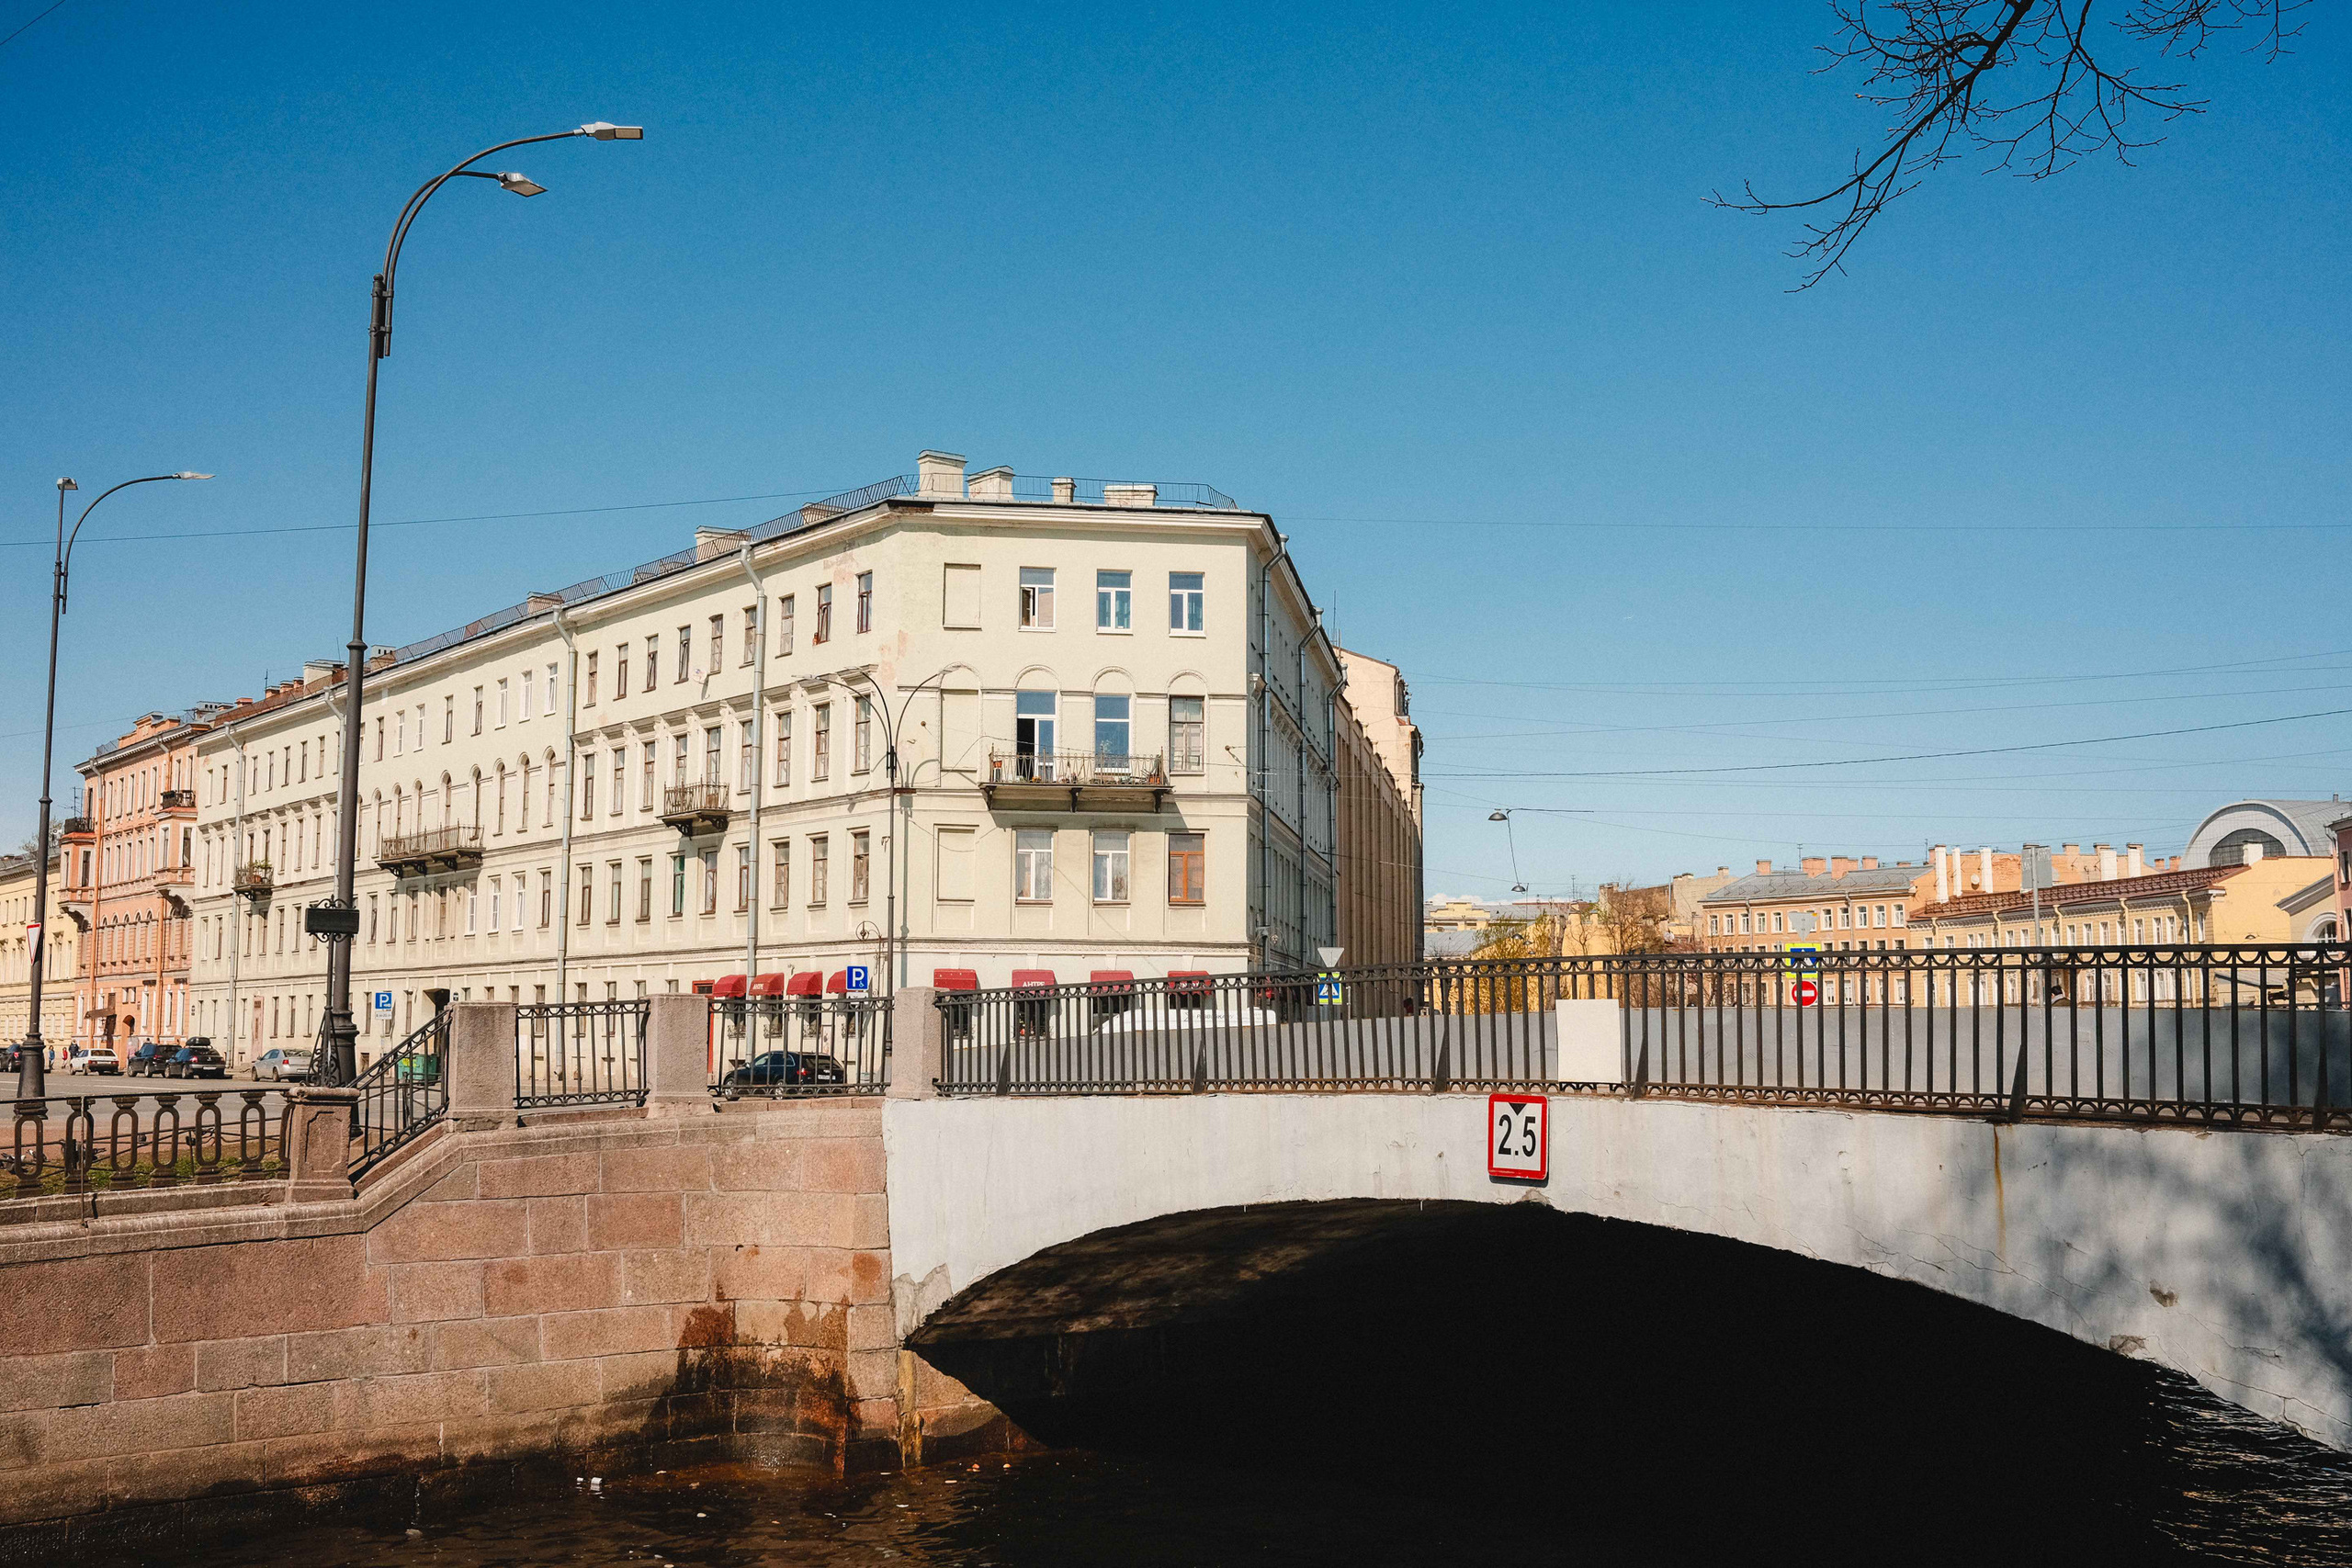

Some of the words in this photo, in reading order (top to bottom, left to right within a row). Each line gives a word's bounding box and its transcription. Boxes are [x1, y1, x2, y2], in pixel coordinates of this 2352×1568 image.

[852, 968, 865, 987] P
[379, 994, 390, 1008] P
[1498, 1113, 1536, 1157] 2.5
